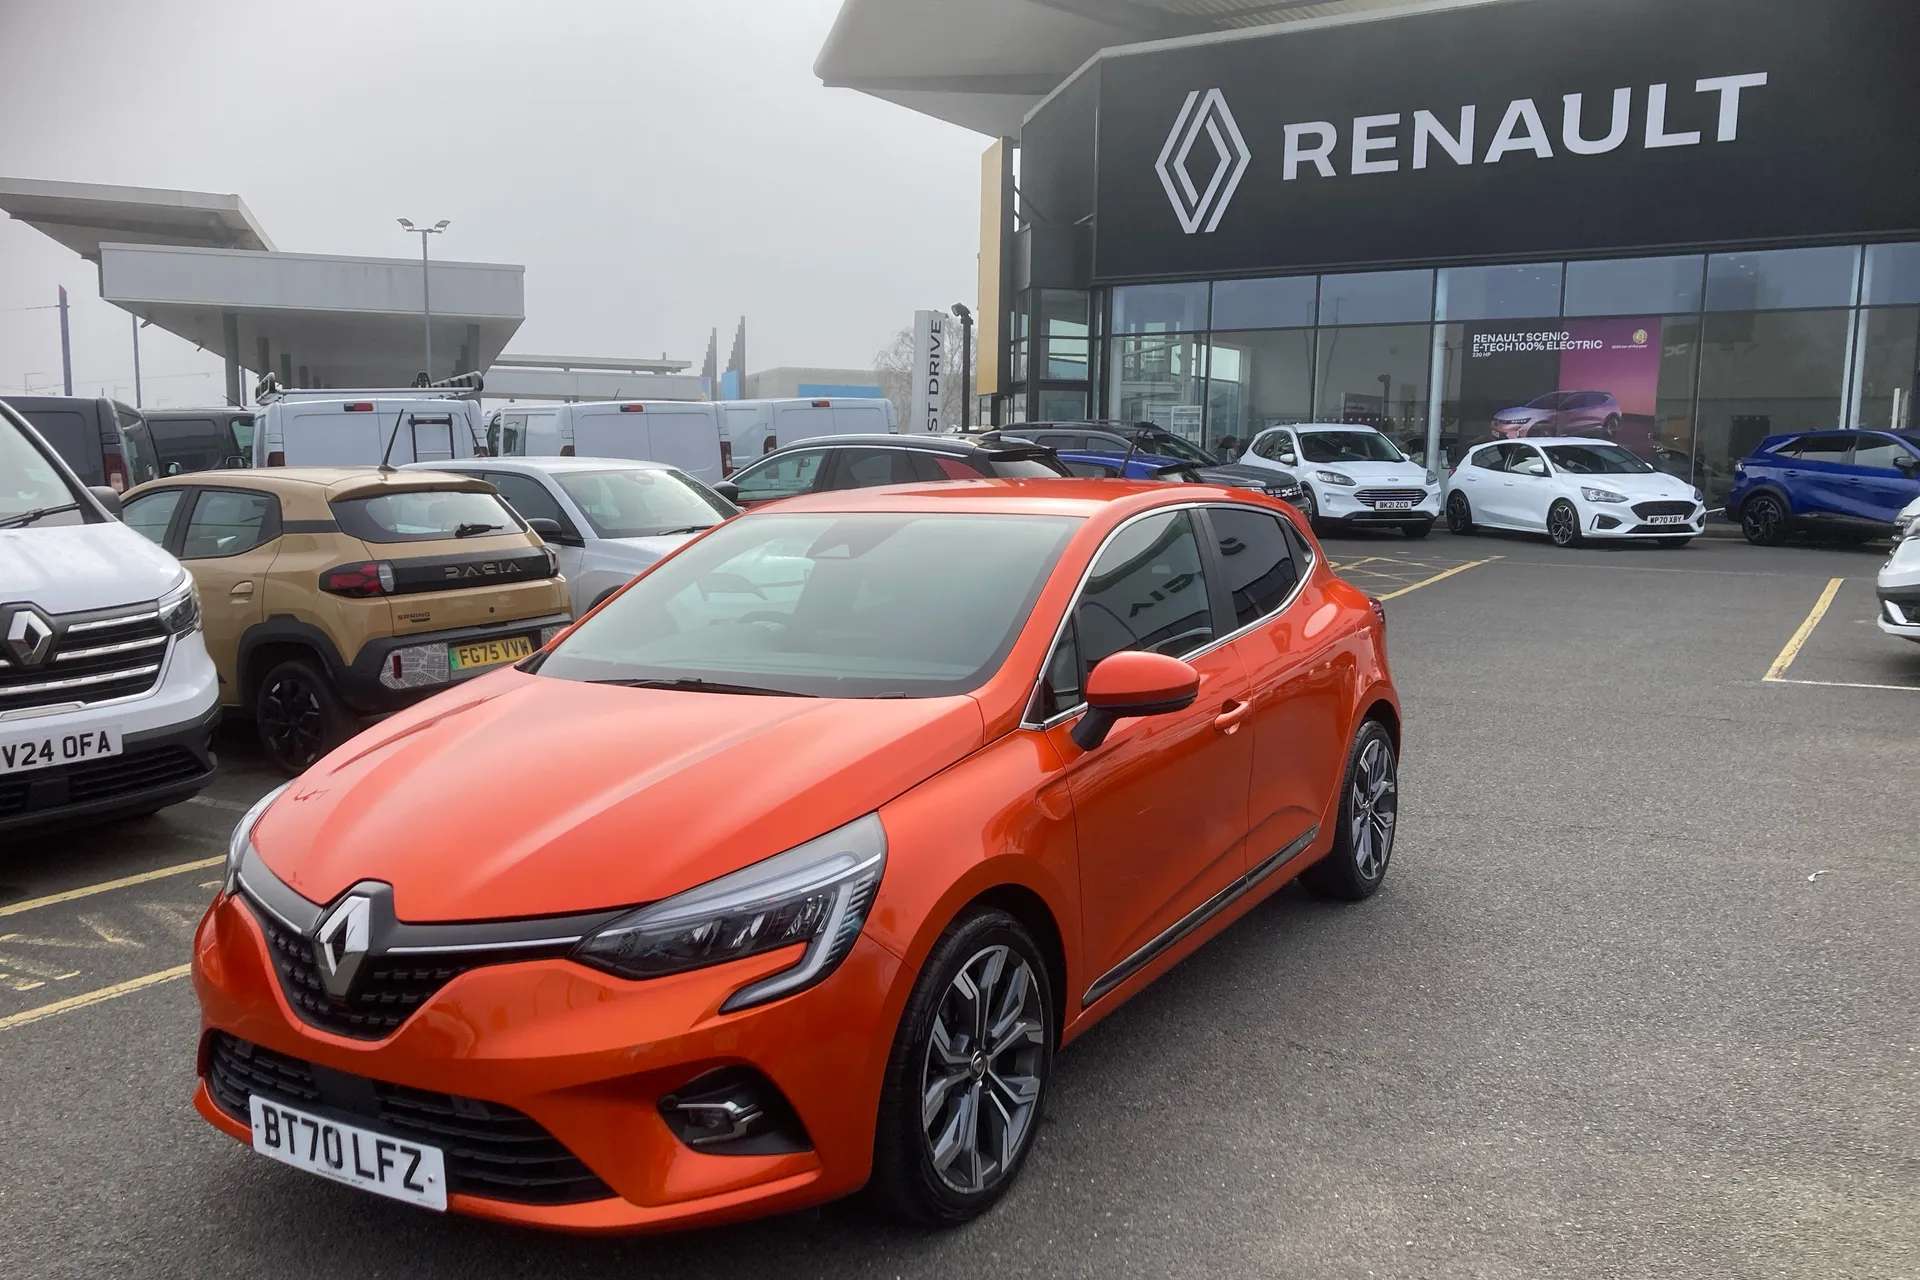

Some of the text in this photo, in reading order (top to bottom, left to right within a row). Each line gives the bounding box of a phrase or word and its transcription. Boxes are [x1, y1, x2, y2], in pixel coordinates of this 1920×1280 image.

[1283, 71, 1768, 181] RENAULT
[1473, 331, 1570, 343] RENAULT SCENIC
[1473, 342, 1513, 352] E-TECH
[1514, 341, 1545, 351] 100%
[1547, 339, 1603, 351] ELECTRIC
[929, 319, 941, 395] DRIVE
[444, 560, 521, 579] DACIA
[459, 644, 500, 666] FG75
[62, 730, 111, 759] OFA
[262, 1103, 424, 1193] BT70 LFZ
